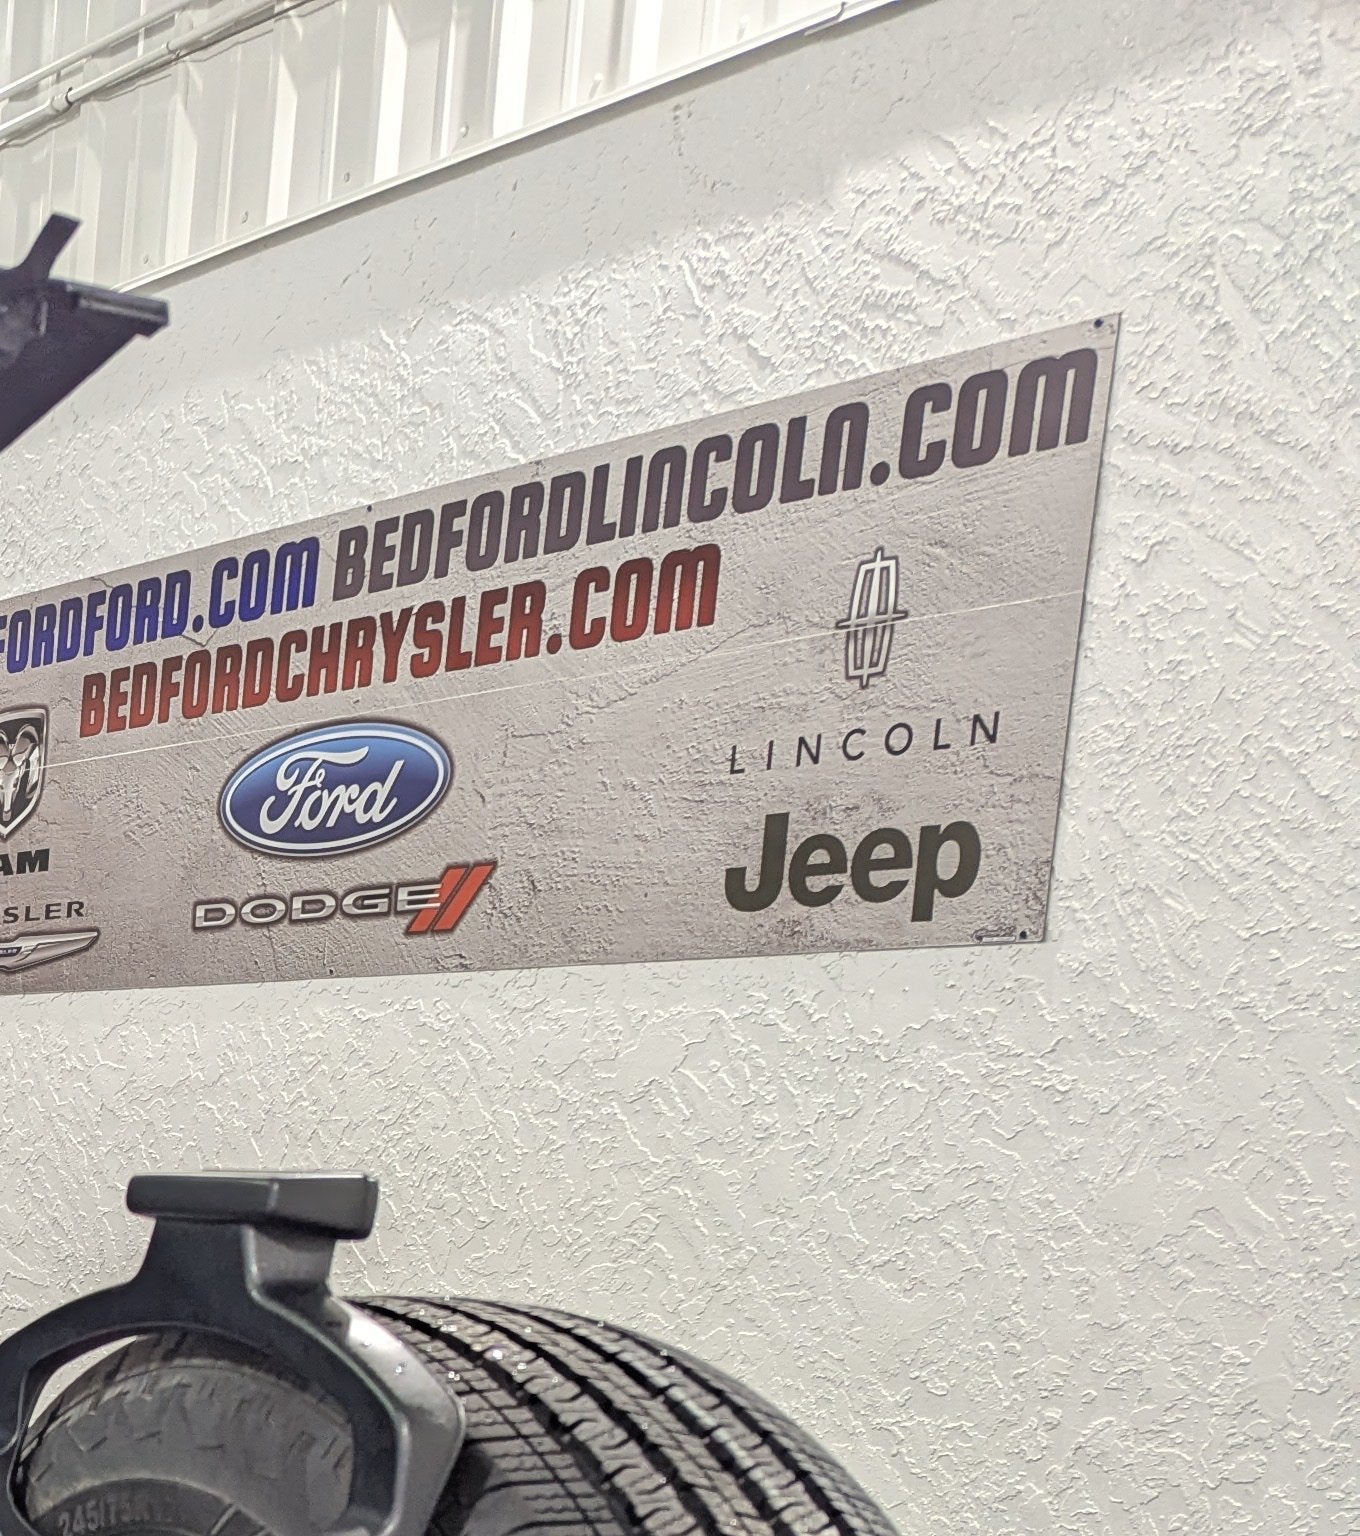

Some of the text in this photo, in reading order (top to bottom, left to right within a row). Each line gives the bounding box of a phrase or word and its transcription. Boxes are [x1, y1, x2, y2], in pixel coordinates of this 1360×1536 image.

[332, 347, 1098, 602] BEDFORDLINCOLN.COM
[80, 543, 721, 738] BEDFORDCHRYSLER.COM
[259, 746, 405, 834] Ford
[729, 711, 1000, 775] LINCOLN
[193, 883, 443, 928] DODGE
[725, 812, 981, 922] Jeep
